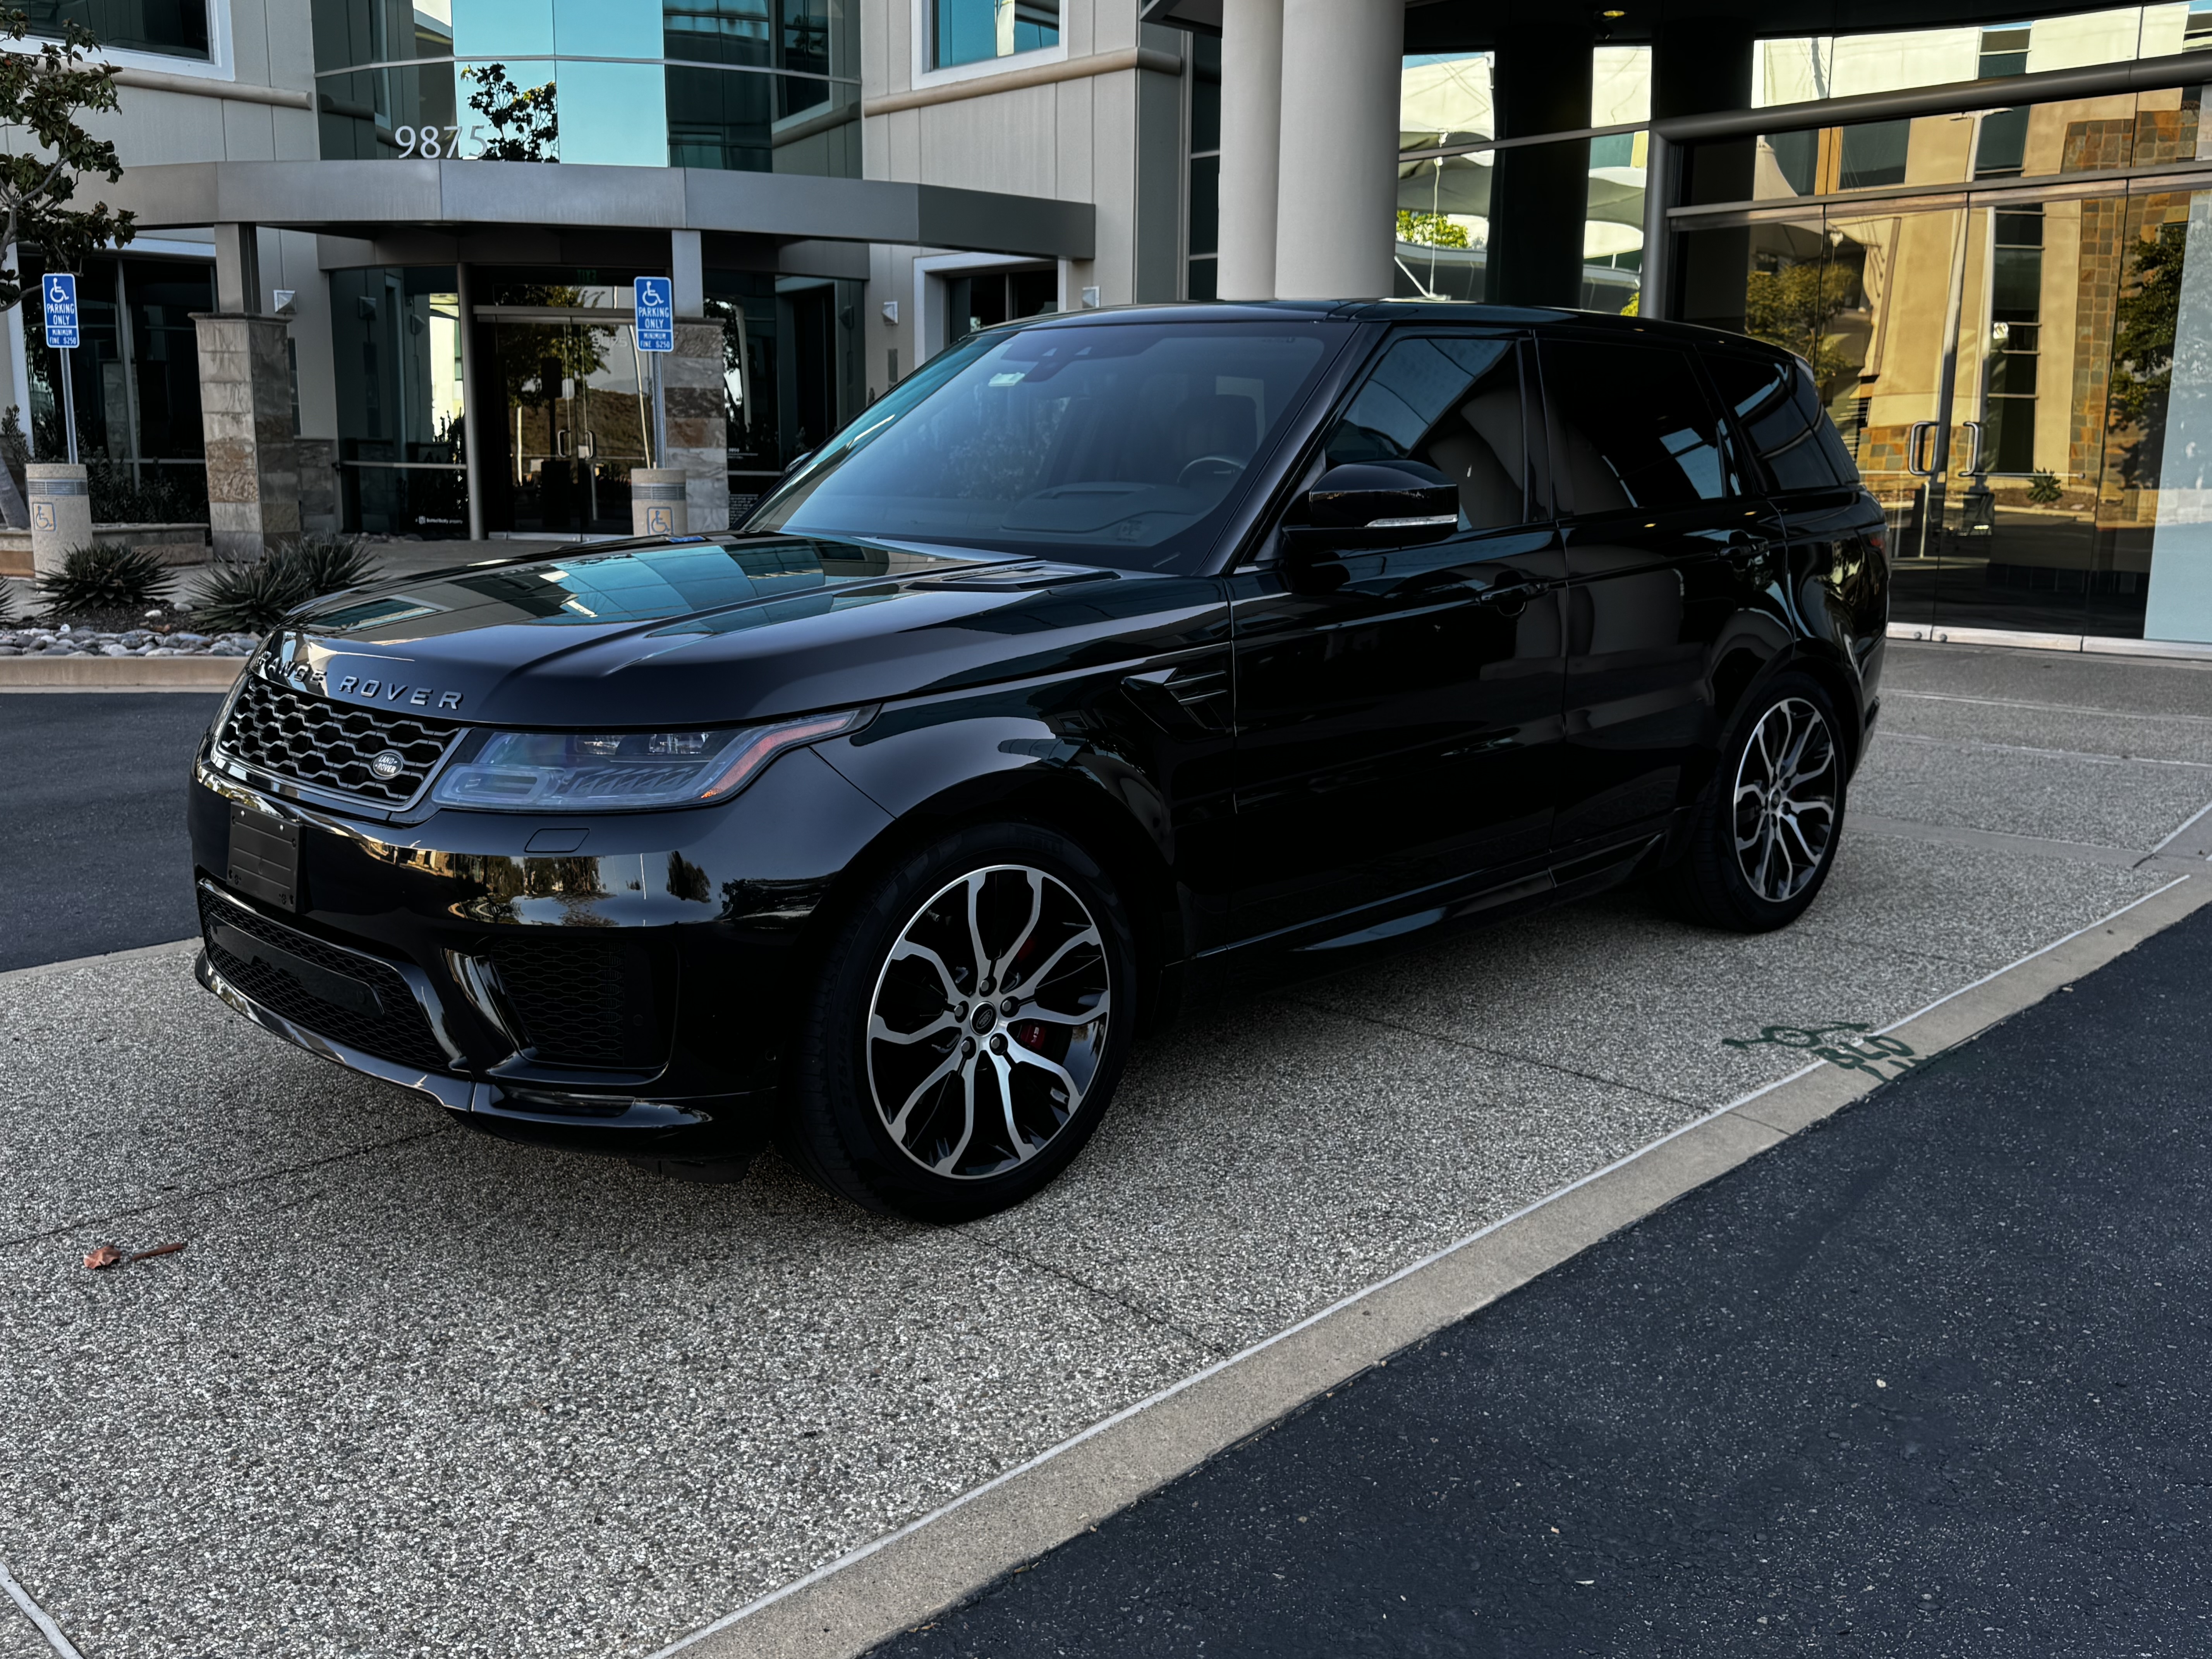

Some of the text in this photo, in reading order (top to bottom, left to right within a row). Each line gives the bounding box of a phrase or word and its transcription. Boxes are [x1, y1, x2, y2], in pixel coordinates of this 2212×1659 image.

[395, 125, 487, 159] 9875
[46, 303, 75, 314] PARKING
[638, 307, 670, 318] PARKING
[53, 314, 70, 325] ONLY
[645, 318, 664, 328] ONLY
[257, 651, 464, 709] RANGE ROVER
[378, 756, 395, 764] LAND
[376, 763, 397, 773] ROVER
